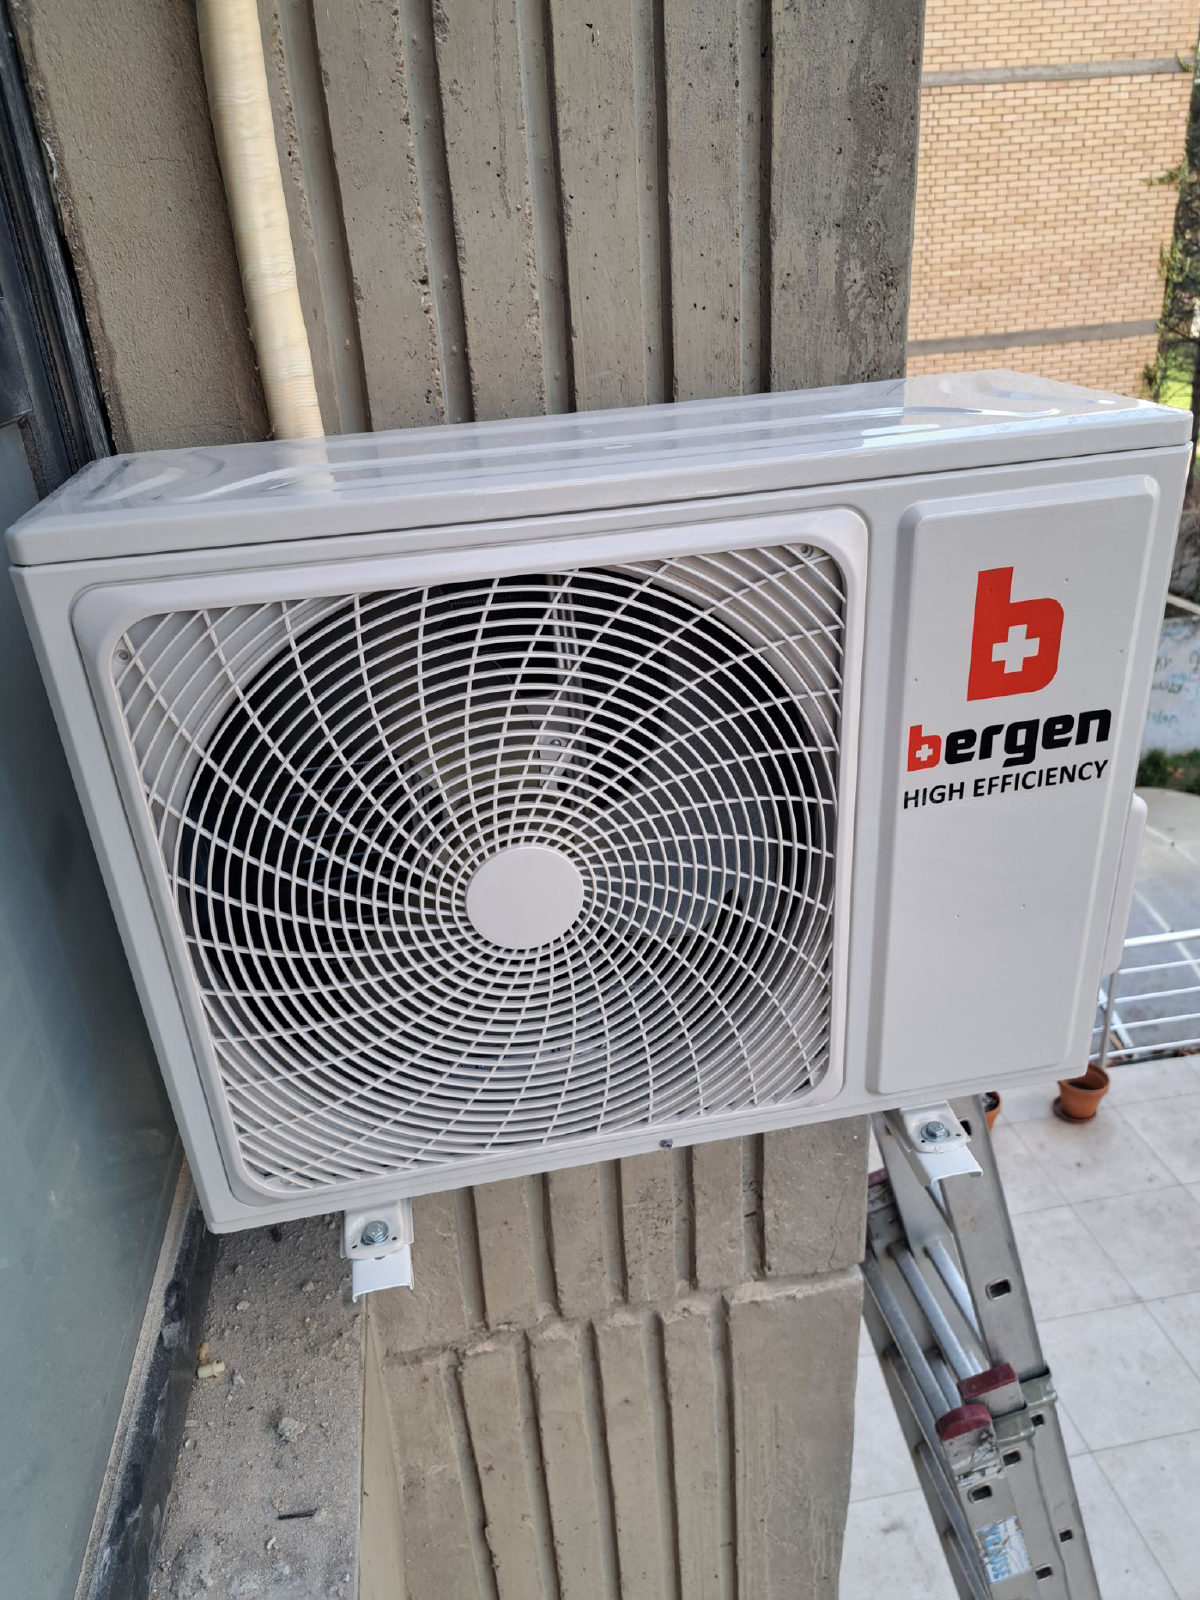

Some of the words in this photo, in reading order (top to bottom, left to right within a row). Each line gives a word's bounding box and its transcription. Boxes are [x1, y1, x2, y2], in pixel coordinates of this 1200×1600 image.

[966, 566, 1064, 702] b
[907, 709, 1112, 772] bergen
[903, 782, 964, 810] HIGH
[973, 759, 1108, 798] EFFICIENCY
